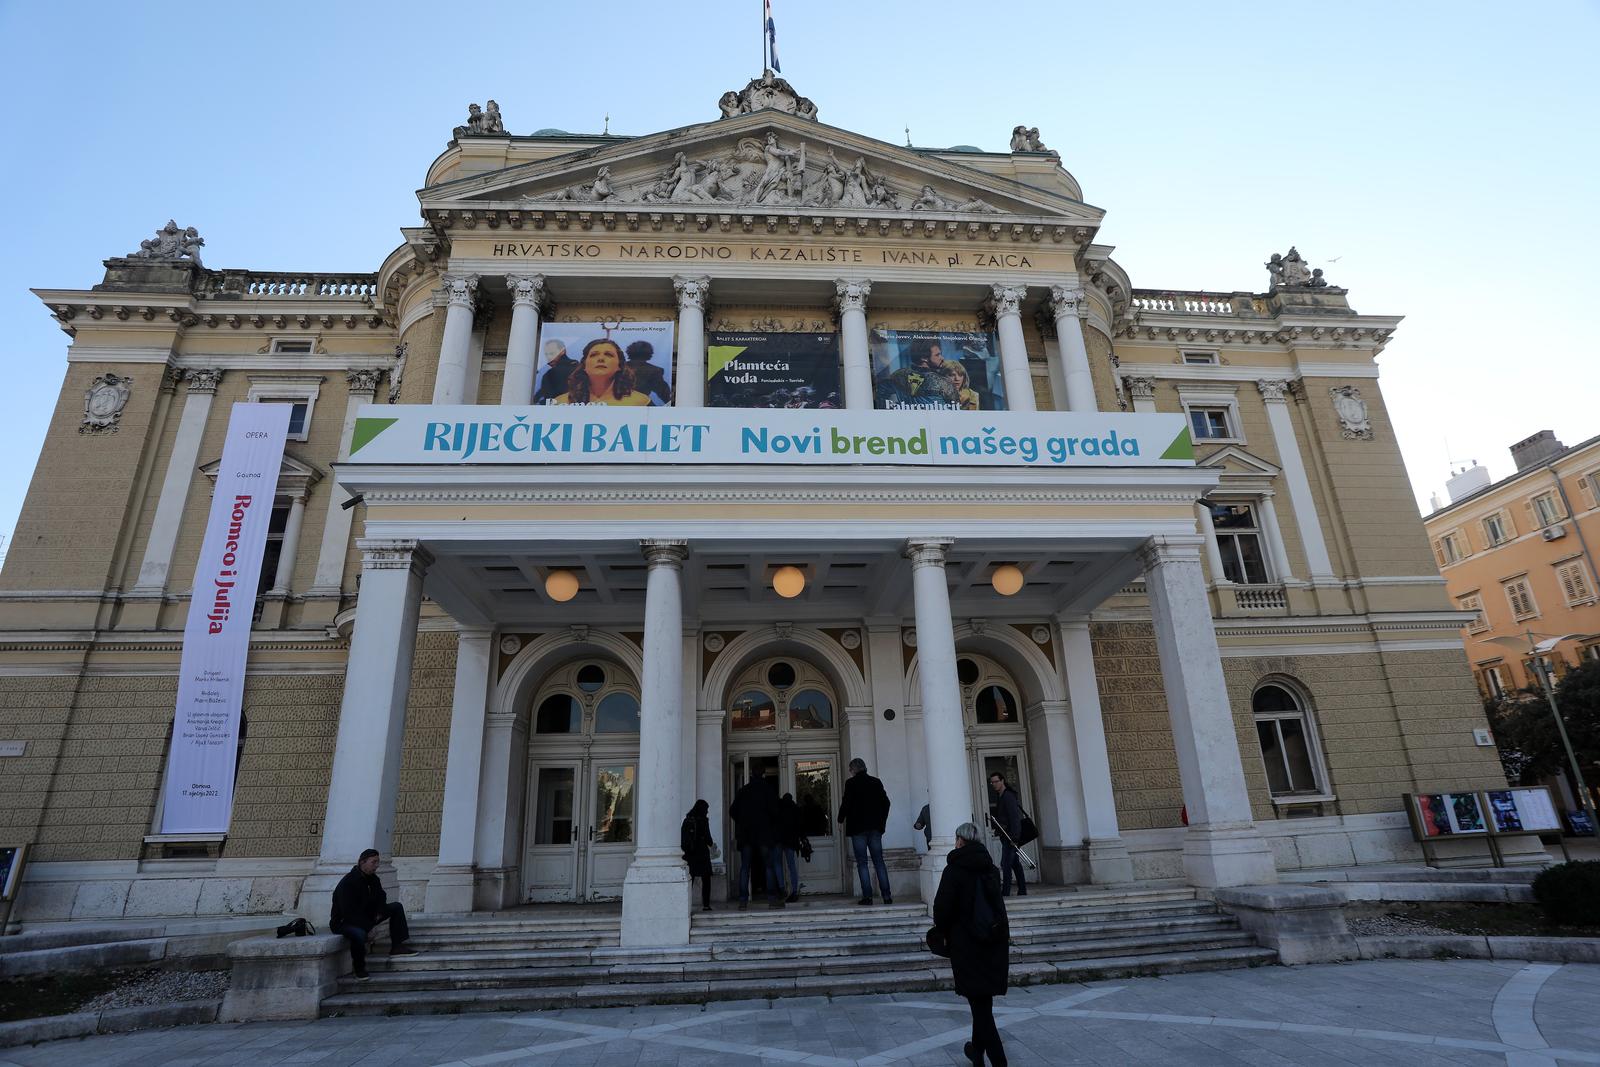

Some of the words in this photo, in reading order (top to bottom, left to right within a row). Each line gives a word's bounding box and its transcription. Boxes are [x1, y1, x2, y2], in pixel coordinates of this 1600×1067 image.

[492, 243, 601, 258] HRVATSKO
[619, 244, 732, 259] NARODNO
[749, 246, 863, 262] KAZALIŠTE
[882, 250, 940, 265] IVANA
[948, 252, 963, 268] pl.
[724, 359, 790, 371] Plamteća
[723, 372, 758, 384] voda
[885, 399, 962, 411] Fahrenheit
[245, 431, 268, 439] OPERA
[423, 414, 573, 461] RIJEČKI
[582, 423, 710, 453] BALET
[741, 426, 822, 454] Novi
[831, 427, 928, 455] brend
[940, 426, 1039, 462] našeg
[1046, 430, 1140, 463] grada
[222, 495, 252, 566] Romeo
[207, 578, 235, 635] Julija
